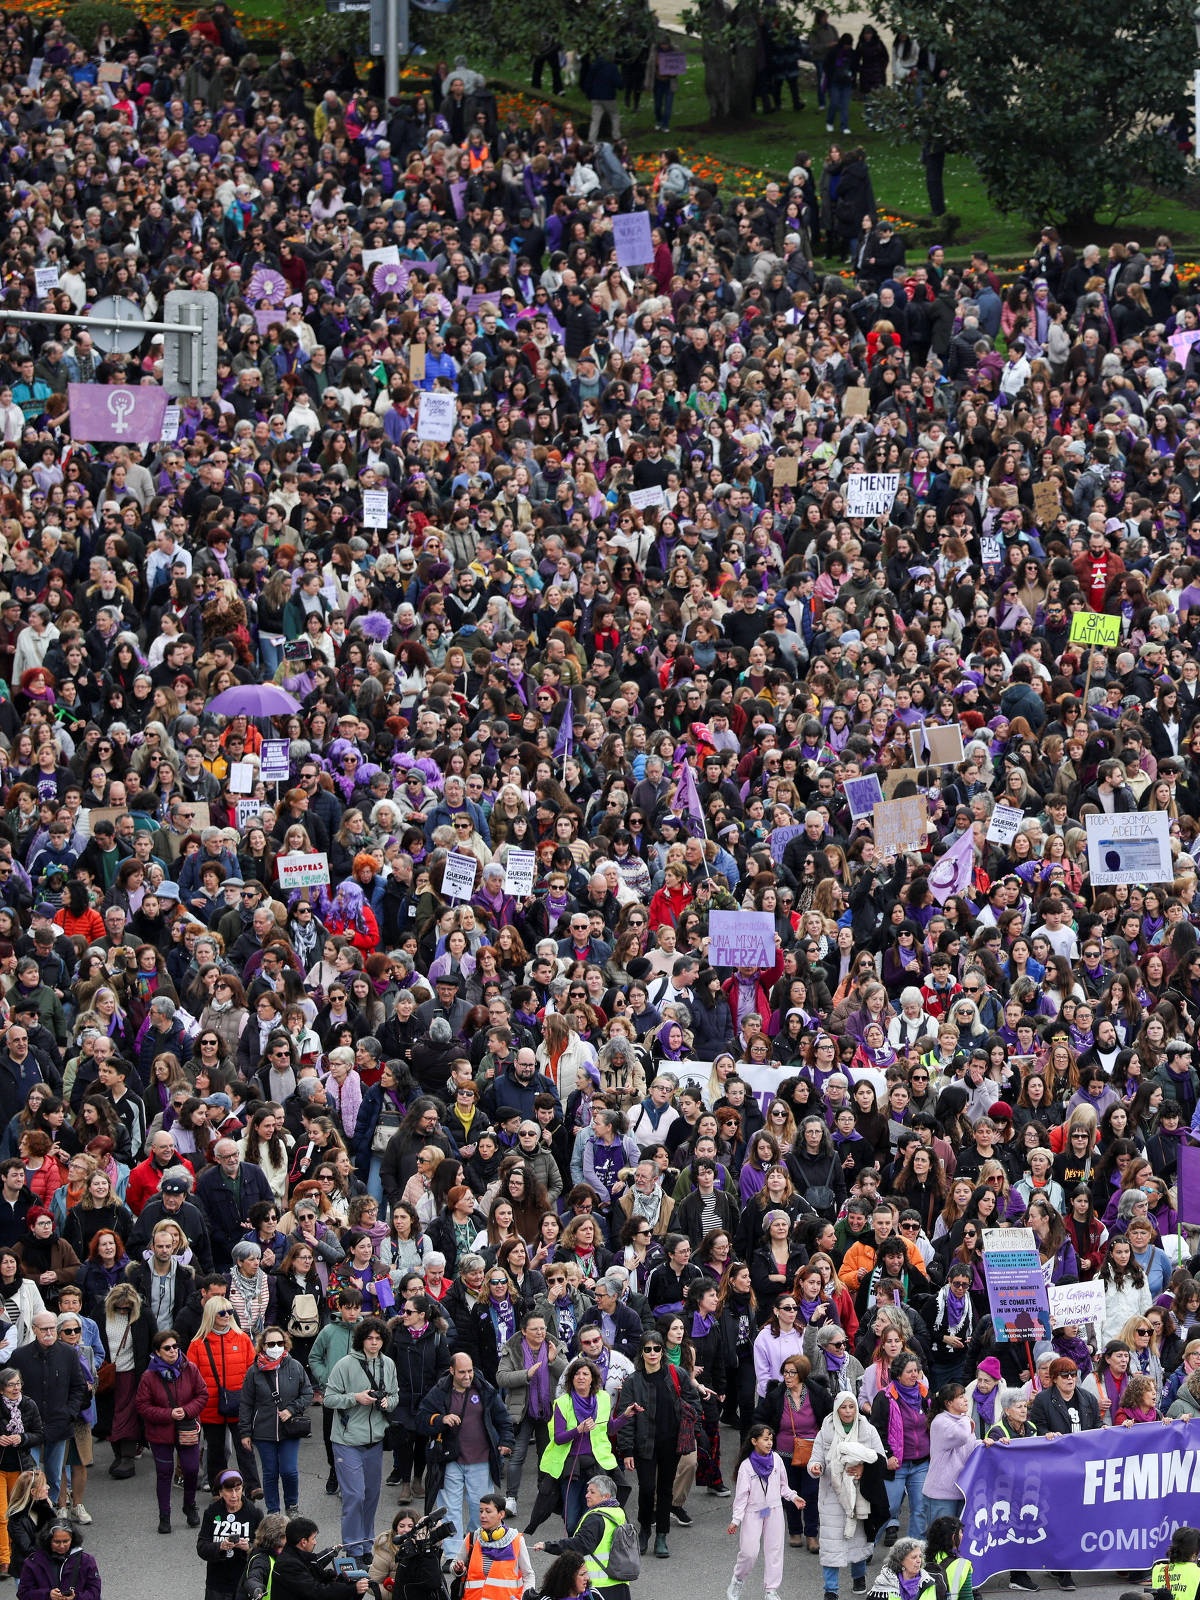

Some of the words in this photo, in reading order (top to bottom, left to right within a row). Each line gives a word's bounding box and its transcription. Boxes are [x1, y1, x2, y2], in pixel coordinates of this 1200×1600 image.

[859, 475, 897, 492] MENTE
[982, 538, 1000, 552] PAZ
[1087, 614, 1106, 628] 8M
[1073, 622, 1116, 644] LATINA
[240, 809, 258, 825] PAZ
[992, 817, 1018, 829] GUERRA
[1087, 815, 1115, 826] TODAS
[1119, 814, 1158, 825] SOMOS
[1111, 824, 1153, 837] ADELITA
[283, 862, 323, 873] NOSOTRAS
[446, 871, 473, 883] GUERRA
[712, 934, 731, 948] UNA
[735, 934, 766, 949] MISMA
[716, 947, 770, 967] FUERZA
[213, 1520, 250, 1537] 7291
